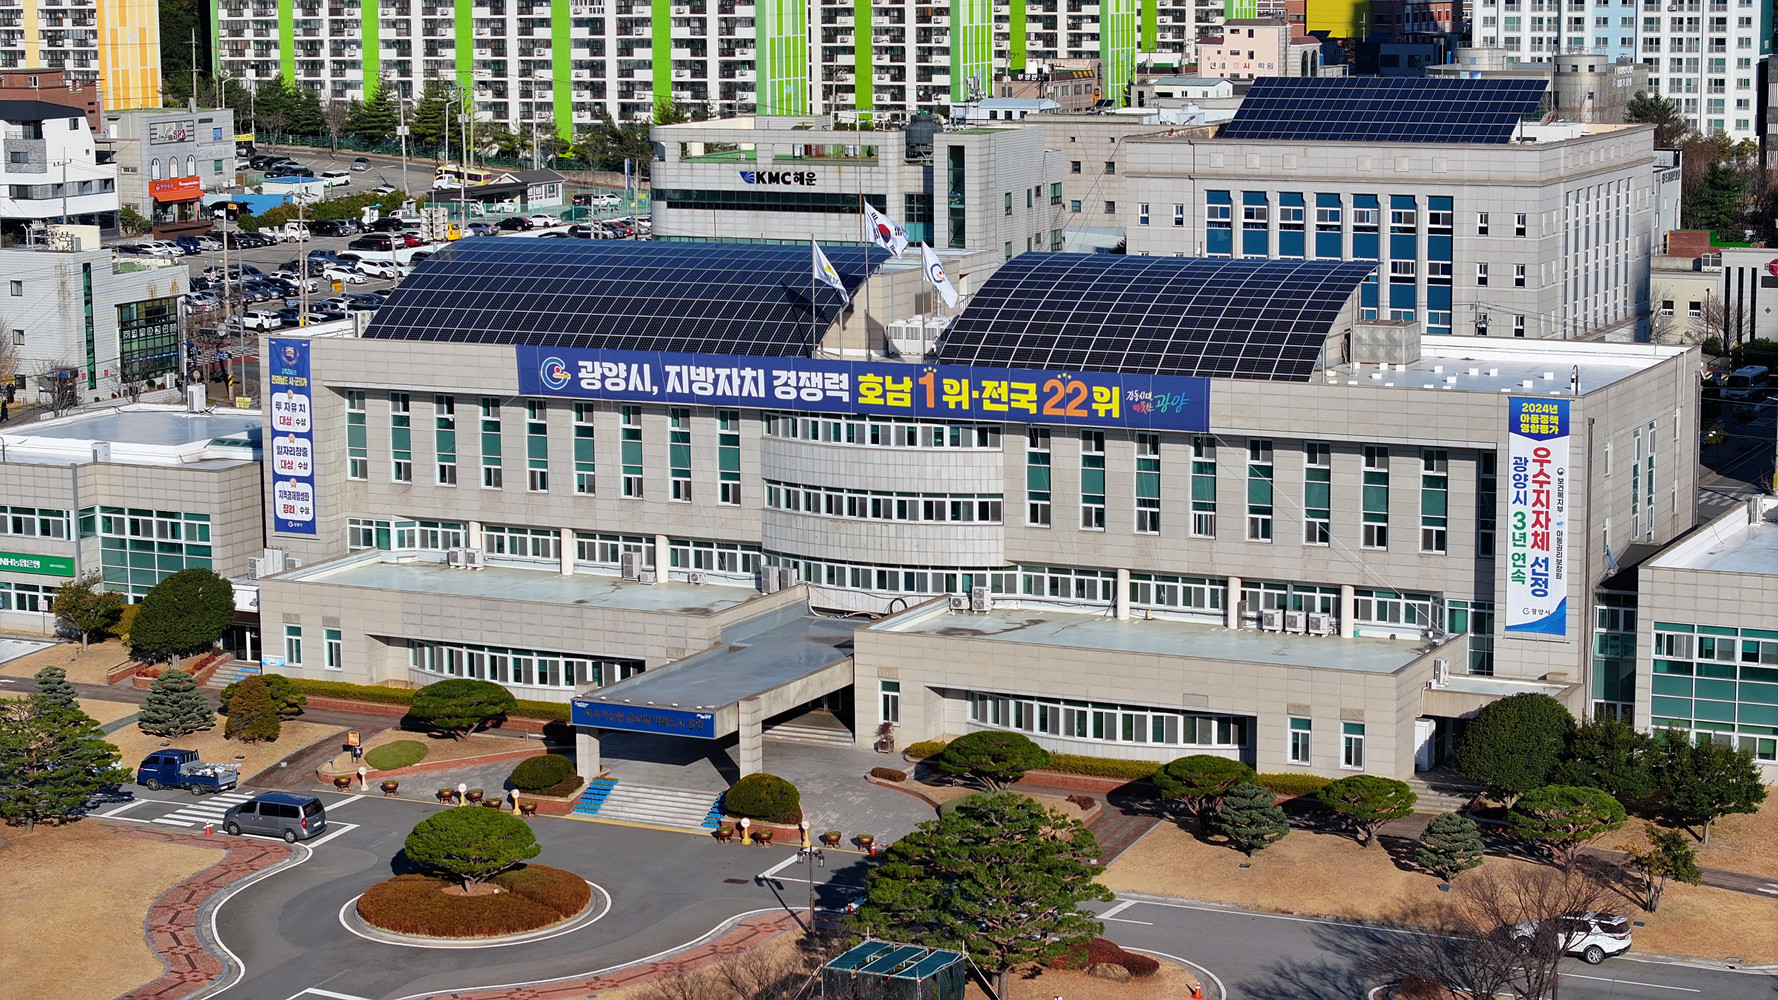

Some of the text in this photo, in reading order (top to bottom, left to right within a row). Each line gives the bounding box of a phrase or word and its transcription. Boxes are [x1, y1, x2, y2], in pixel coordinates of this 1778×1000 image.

[756, 171, 817, 186] KMC해운
[578, 360, 658, 396] 광양시,
[665, 365, 765, 398] 지방자치
[773, 369, 849, 403] 경쟁력
[857, 373, 913, 407] 호남
[1154, 392, 1190, 413] 광양
[1522, 402, 1558, 414] 2024년
[280, 416, 307, 427] 대상 수상
[1520, 413, 1559, 425] 아동정책
[1520, 423, 1559, 435] 영향평가
[276, 445, 308, 457] 일자리창출
[281, 460, 308, 470] 대상 수상
[299, 506, 310, 515] 수상
[1510, 456, 1529, 585] 광양시 3년 연속
[1530, 447, 1552, 598] 우수지자체 선정
[1531, 608, 1551, 616] 광양시
[584, 709, 623, 722] 지속가능한
[625, 712, 650, 725] 글로벌
[652, 715, 685, 728] 미래도시
[687, 718, 704, 731] 광양
